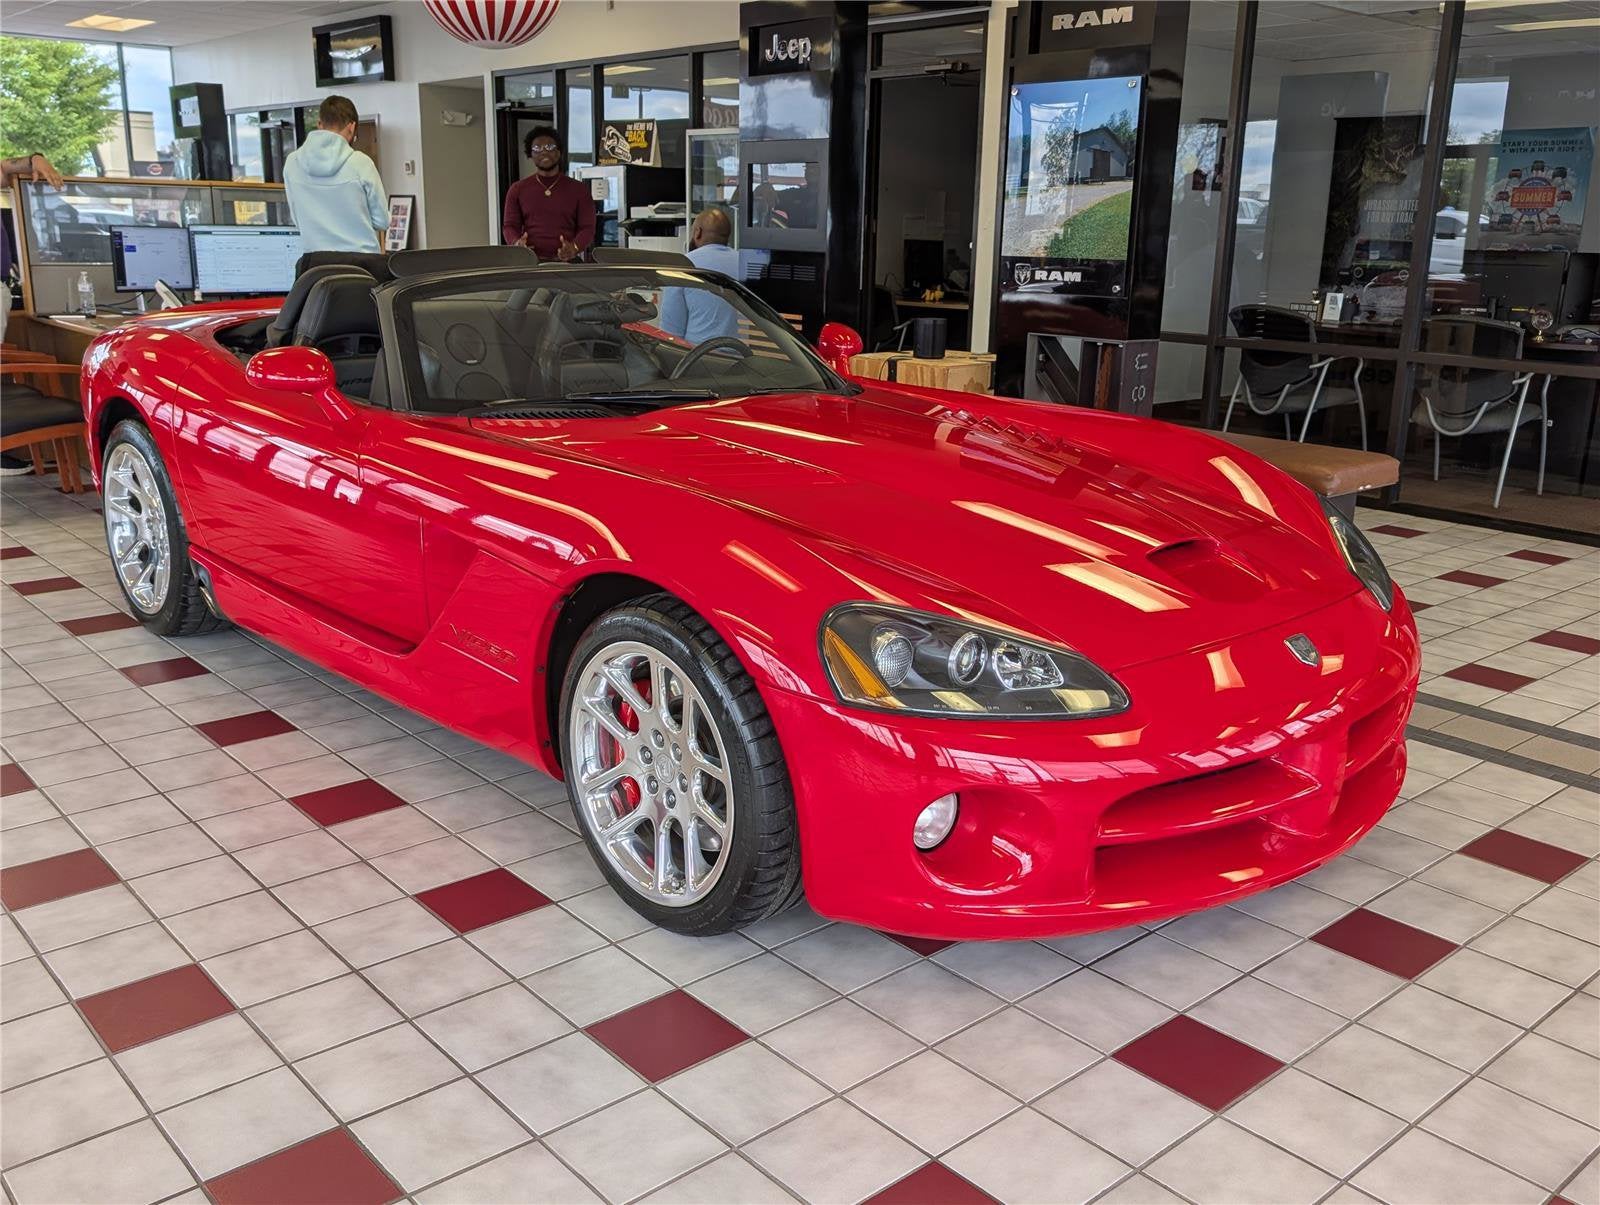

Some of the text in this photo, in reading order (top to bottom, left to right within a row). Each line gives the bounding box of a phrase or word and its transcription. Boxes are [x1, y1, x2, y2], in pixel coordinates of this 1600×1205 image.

[1052, 6, 1133, 31] RAM
[765, 34, 811, 64] Jeep
[1513, 191, 1554, 202] SUMMER
[1396, 211, 1414, 224] TRAIL
[1034, 270, 1082, 282] RAM
